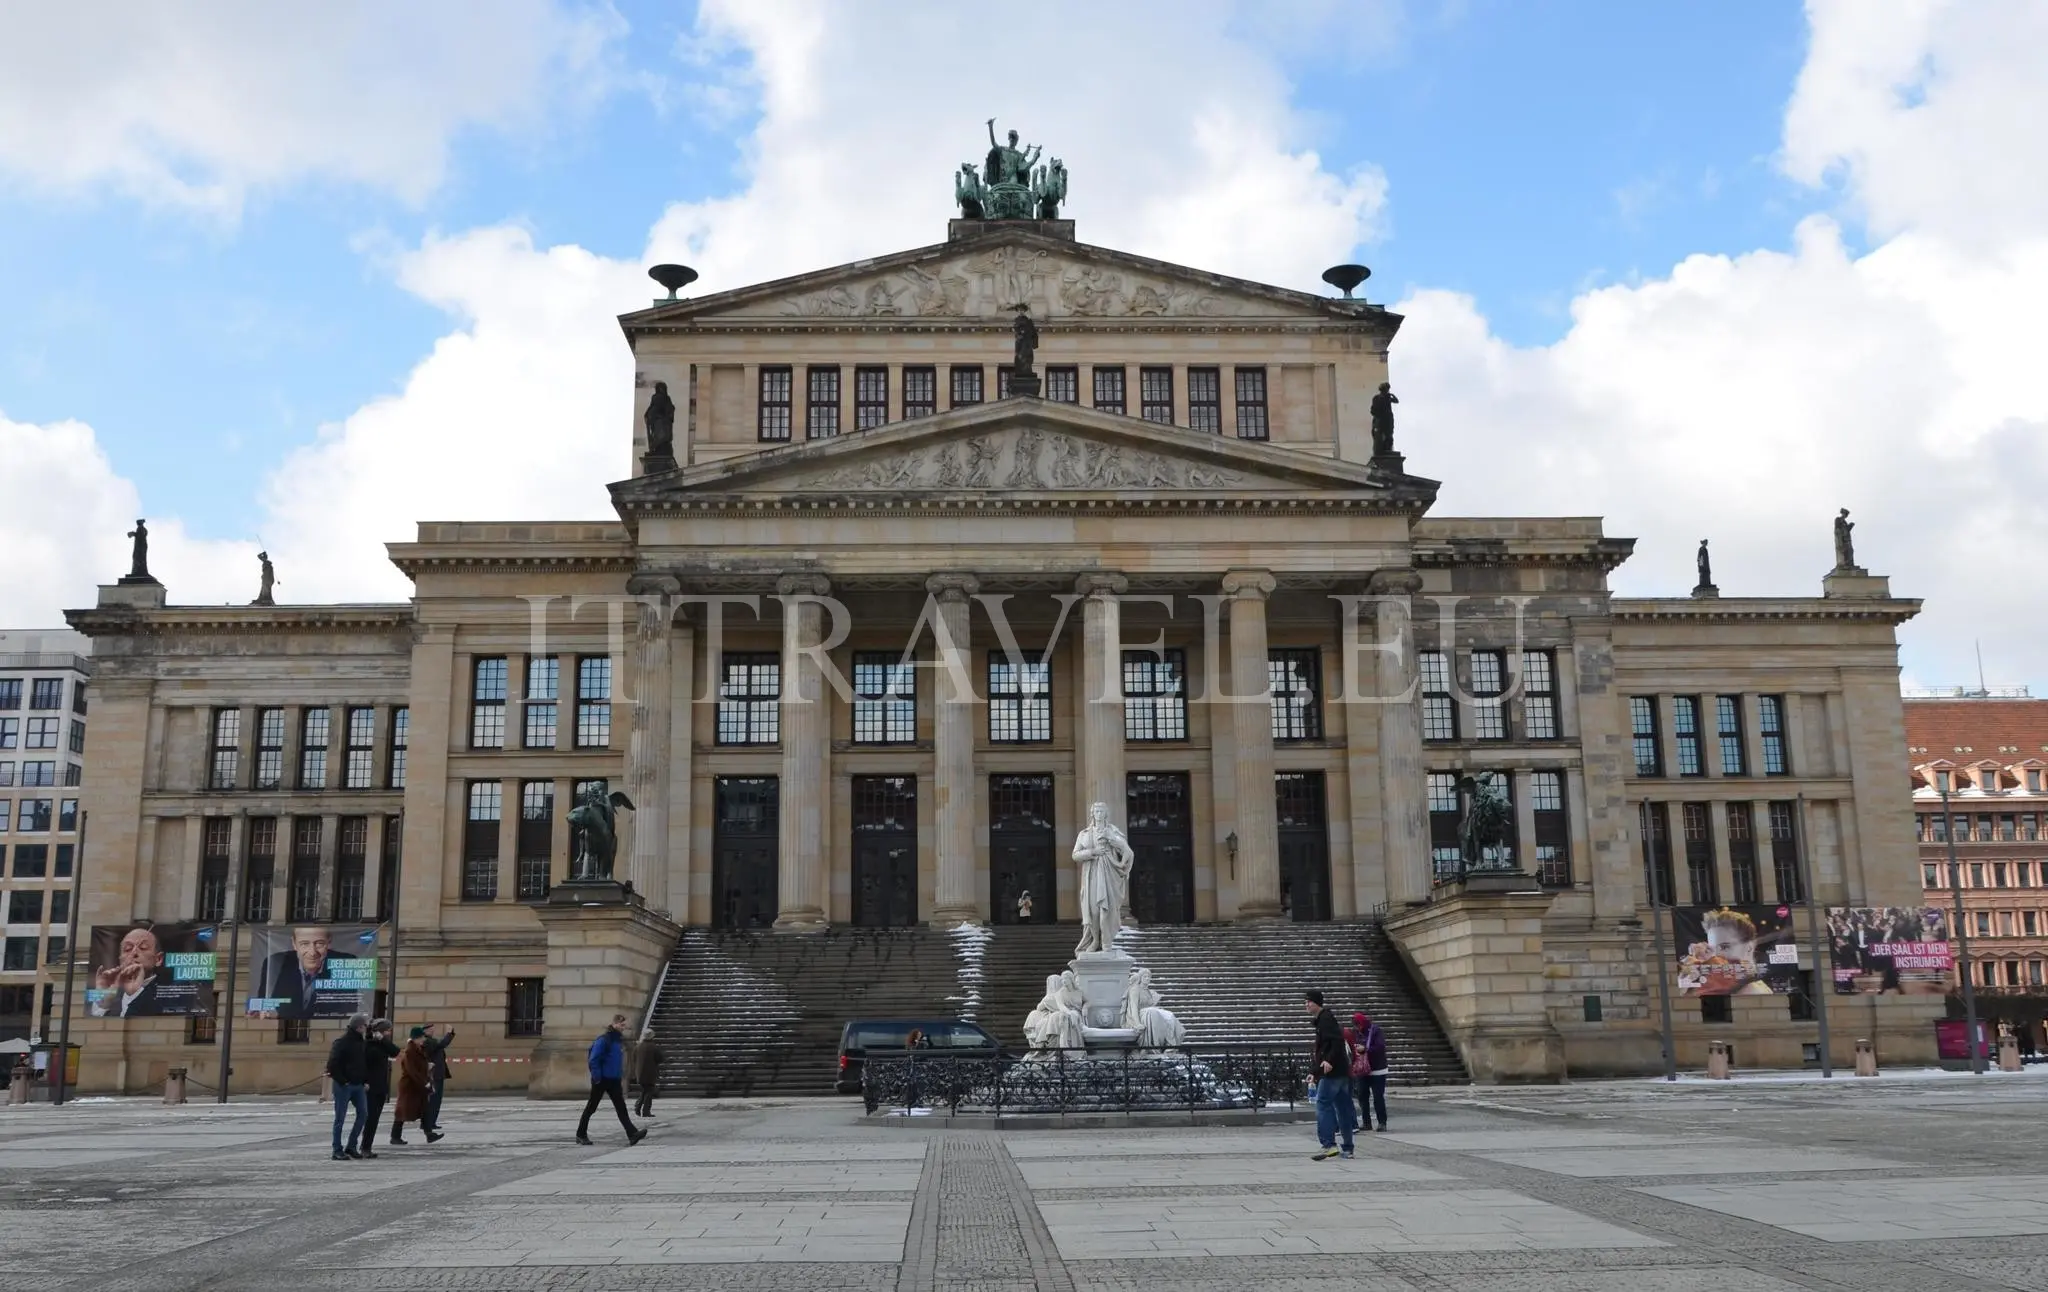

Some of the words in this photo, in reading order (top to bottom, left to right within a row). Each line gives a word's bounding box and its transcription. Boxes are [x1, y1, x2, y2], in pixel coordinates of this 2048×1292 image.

[1892, 943, 1912, 955] SAAL
[1913, 943, 1926, 955] IST
[1927, 943, 1948, 955] MEIN
[200, 953, 213, 966] IST
[331, 969, 352, 978] STEHT
[353, 969, 373, 978] NICHT
[315, 979, 323, 989] IN
[323, 979, 337, 989] DER
